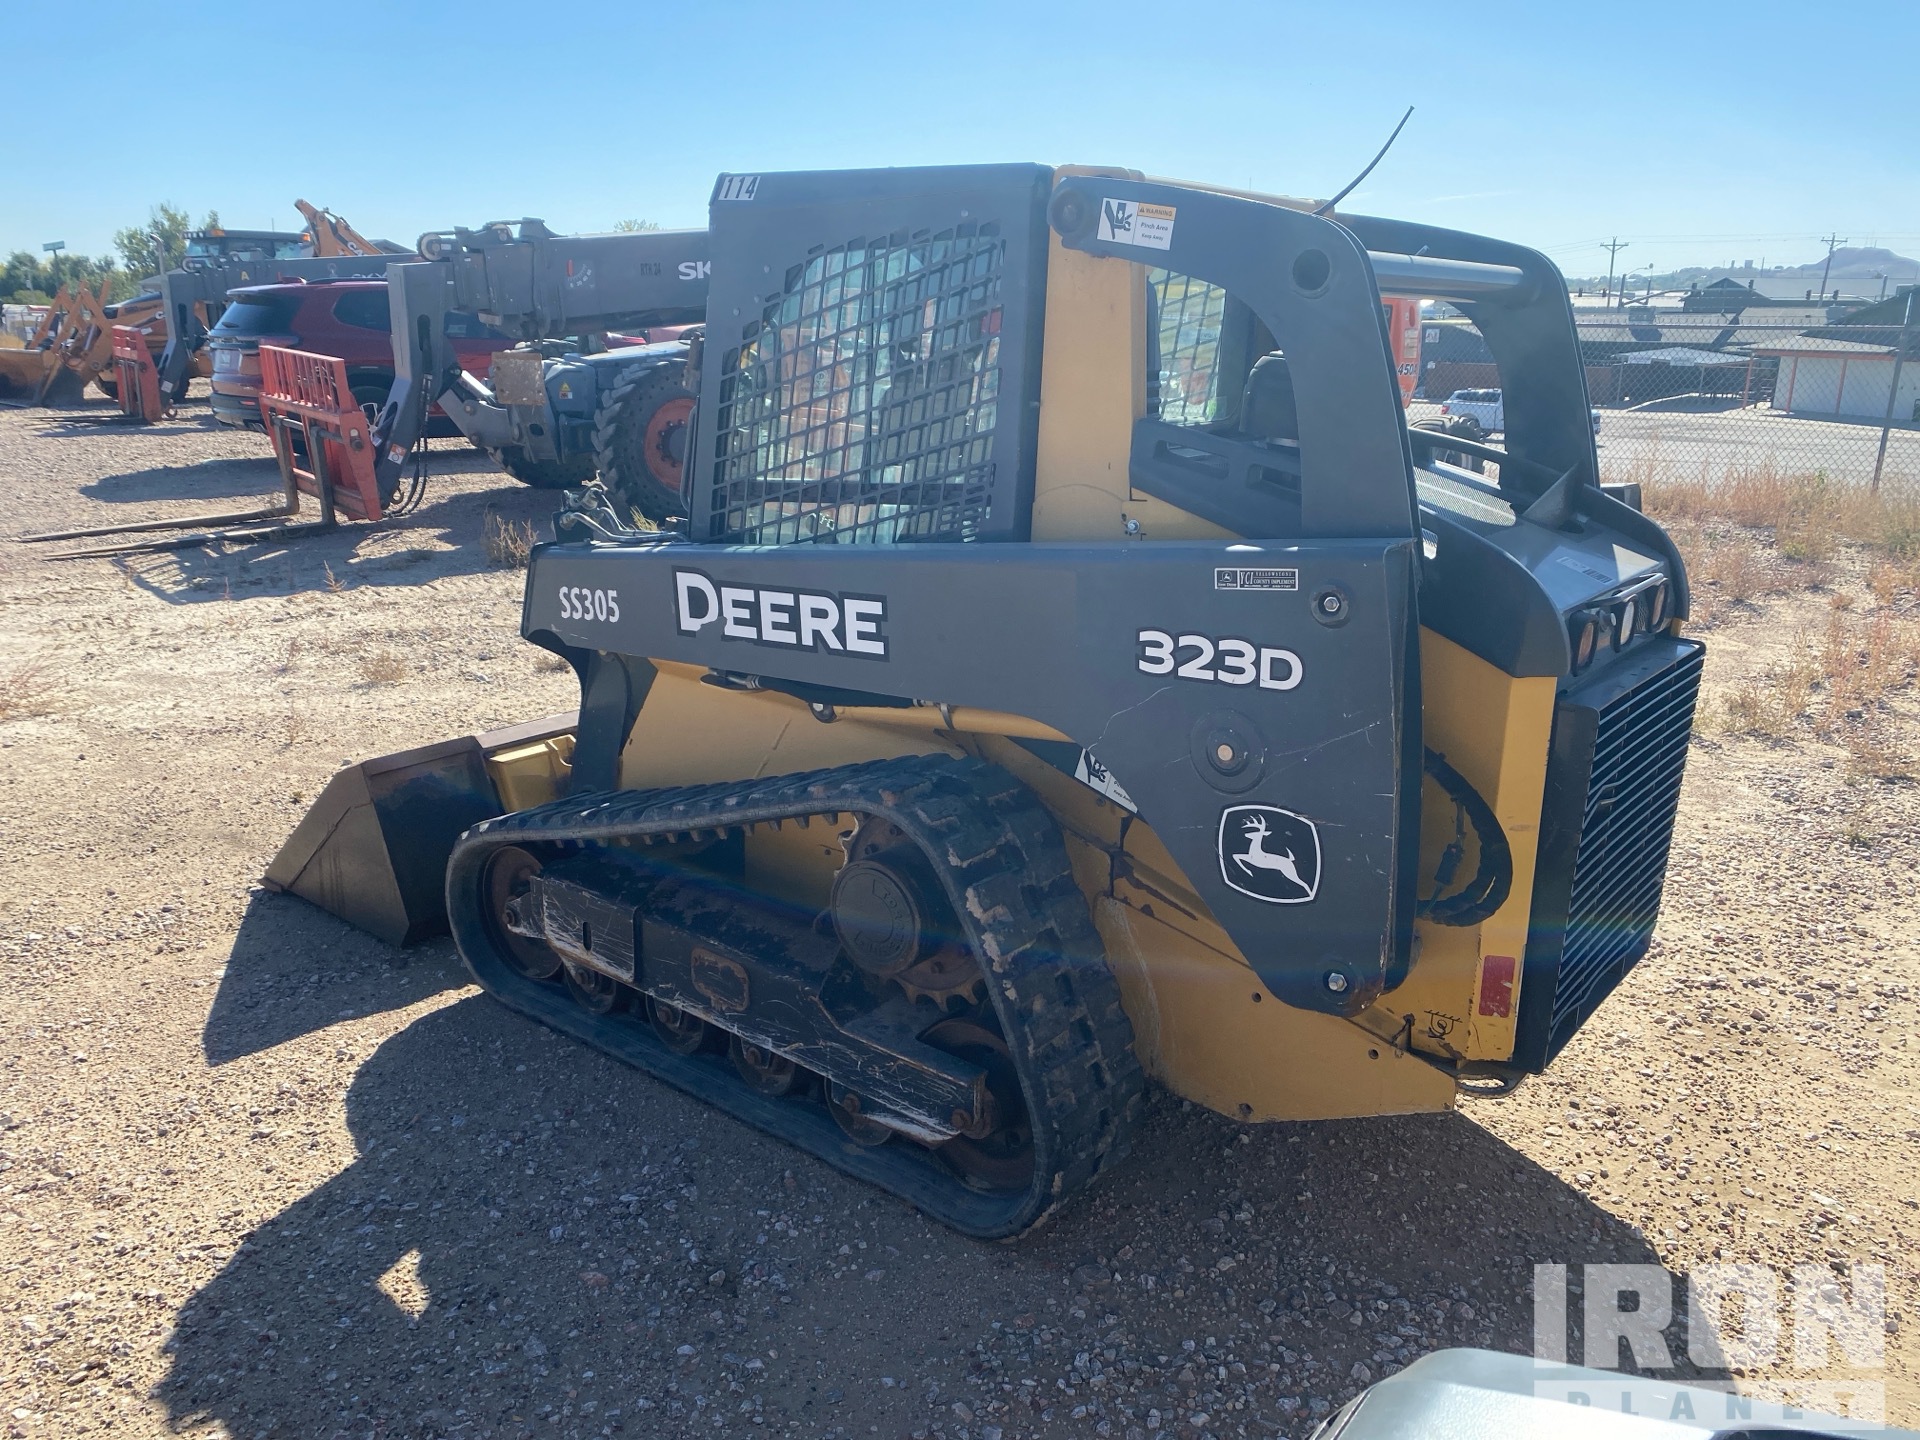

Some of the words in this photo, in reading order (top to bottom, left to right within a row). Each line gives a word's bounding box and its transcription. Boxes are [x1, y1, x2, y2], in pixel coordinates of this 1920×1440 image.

[723, 176, 758, 199] 114
[1145, 207, 1173, 217] WARNING
[1140, 221, 1155, 230] Pinch
[1155, 223, 1169, 231] Area
[1152, 234, 1164, 242] Away
[677, 260, 711, 281] SK
[1240, 571, 1254, 585] YCI
[559, 586, 620, 623] SS305
[675, 571, 885, 655] DEERE
[1138, 630, 1303, 690] 323D
